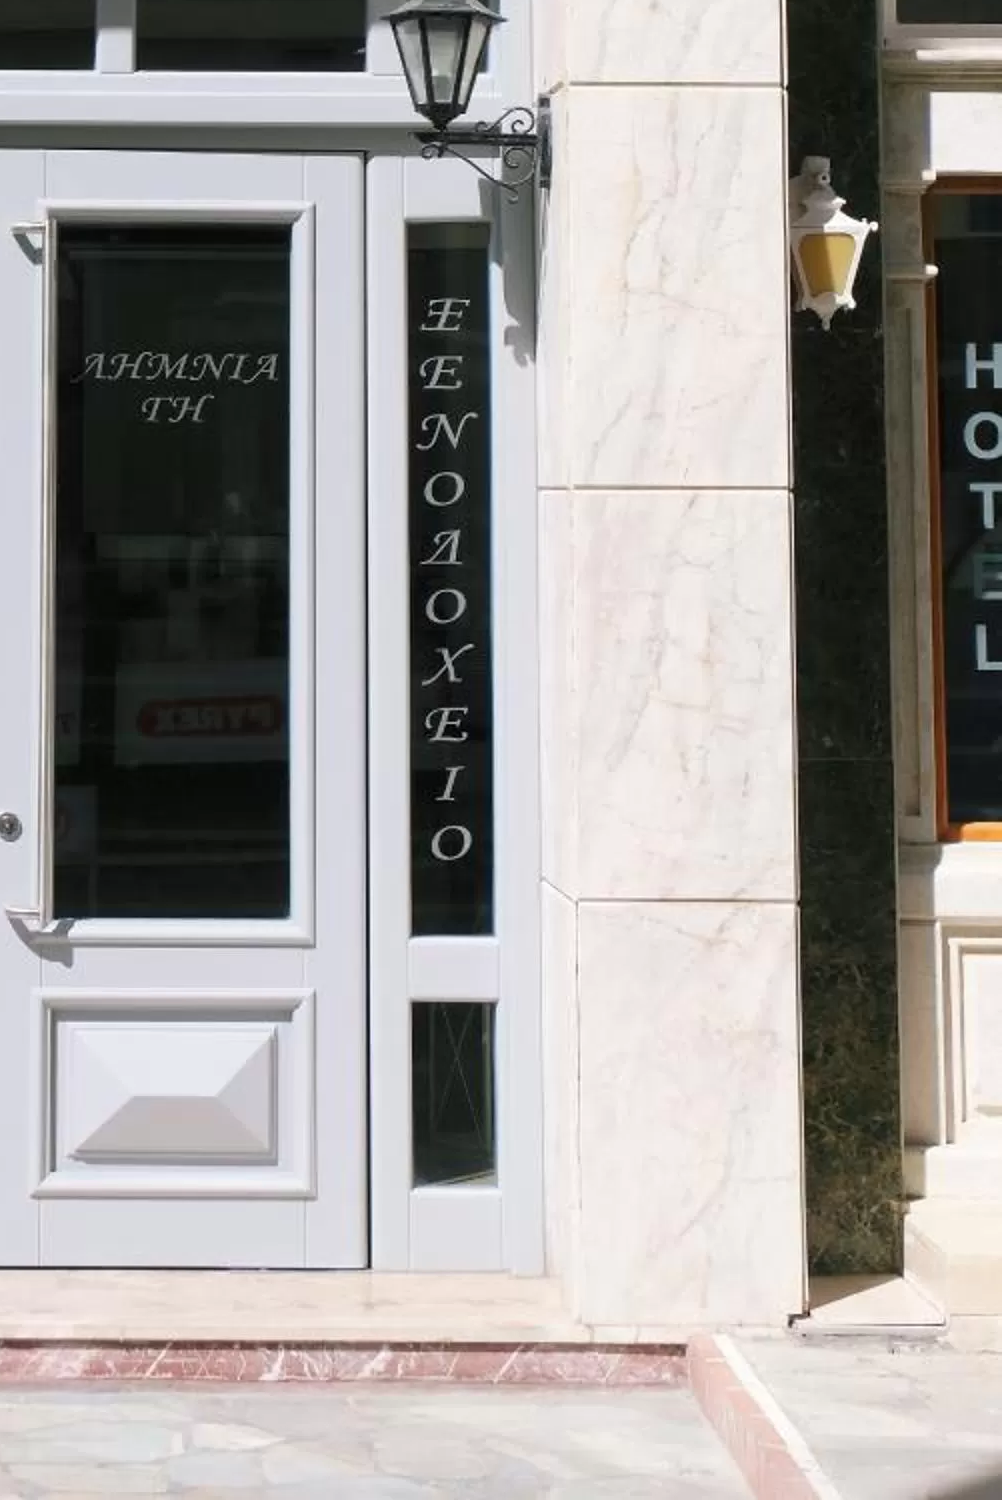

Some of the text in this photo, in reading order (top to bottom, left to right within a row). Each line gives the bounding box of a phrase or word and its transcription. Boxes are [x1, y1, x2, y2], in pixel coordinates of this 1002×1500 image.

[69, 351, 280, 384] ΛΗΜΝΙΑ
[963, 342, 1002, 672] HOTEL
[415, 297, 478, 862] ΞΕΝΟΔΟΧΕΙΟ
